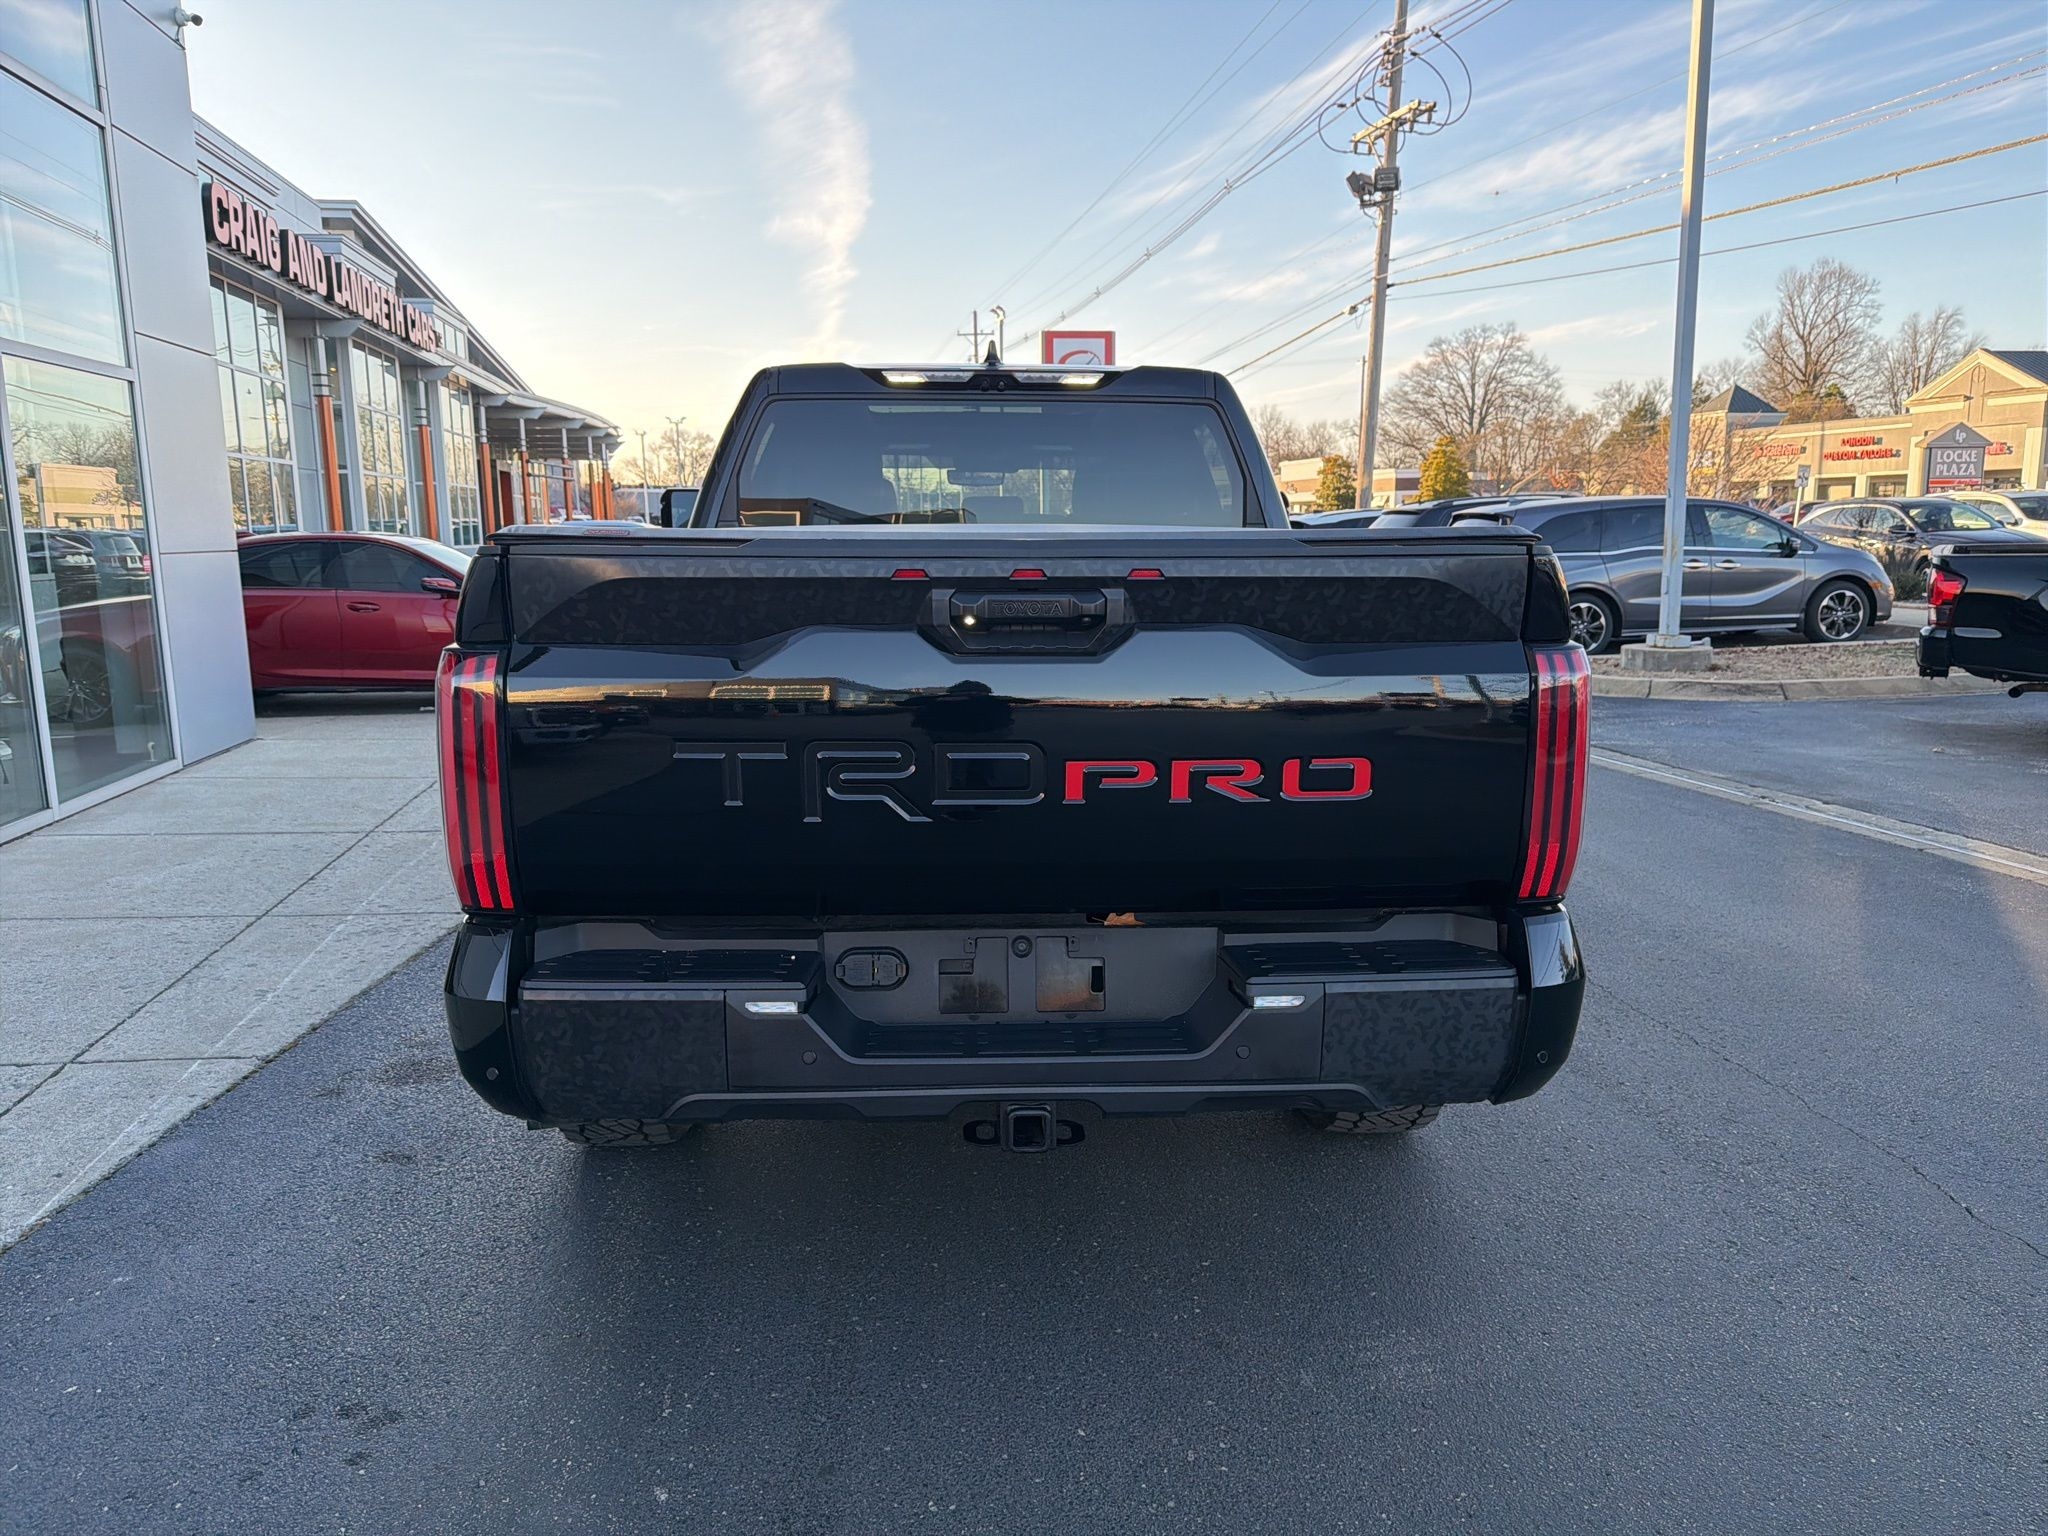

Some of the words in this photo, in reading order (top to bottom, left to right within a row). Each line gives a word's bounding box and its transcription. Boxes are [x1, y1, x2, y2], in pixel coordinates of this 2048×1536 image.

[209, 182, 282, 273] CRAIG
[287, 230, 328, 297] AND
[330, 255, 407, 339] LANDRETH
[406, 303, 437, 352] CARS
[1841, 436, 1876, 447] LONDON
[1823, 451, 1857, 461] CUSTOM
[1860, 448, 1894, 460] TAILORS
[1936, 449, 1978, 462] LOCKE
[1935, 463, 1976, 476] PLAZA
[992, 601, 1065, 616] TOYOTA
[673, 742, 1046, 822] TRD
[1062, 757, 1374, 803] PRO
